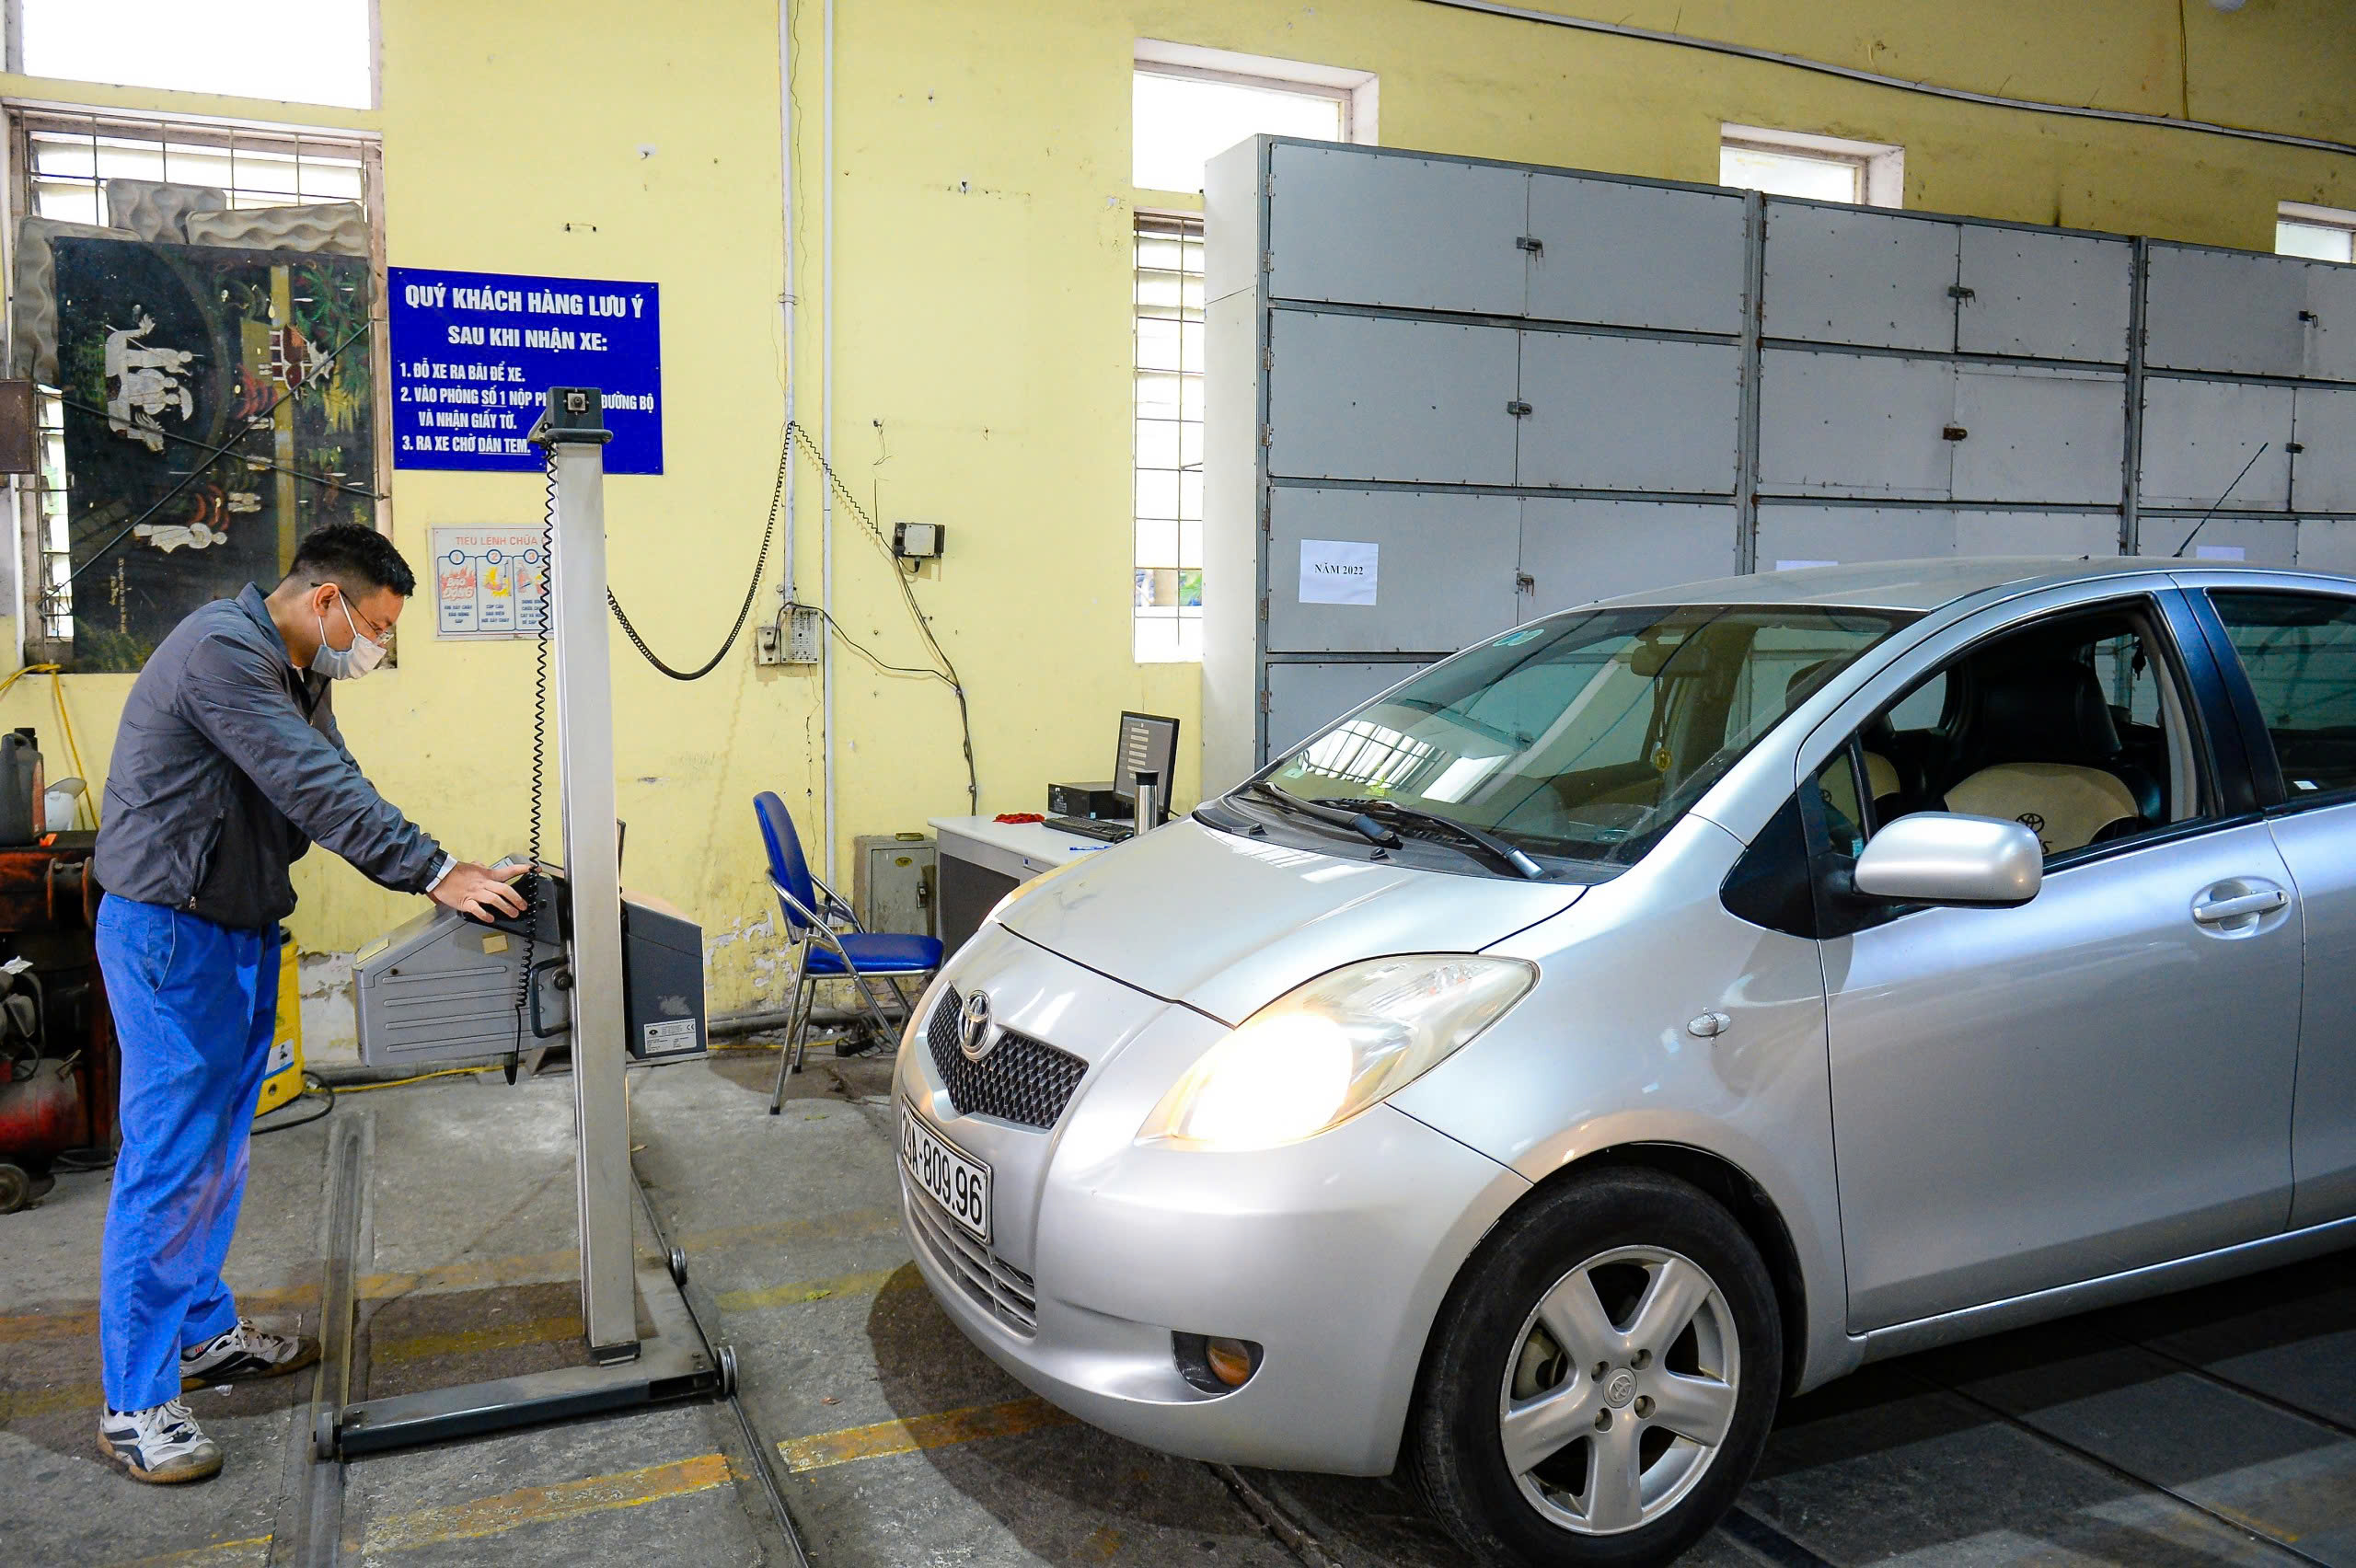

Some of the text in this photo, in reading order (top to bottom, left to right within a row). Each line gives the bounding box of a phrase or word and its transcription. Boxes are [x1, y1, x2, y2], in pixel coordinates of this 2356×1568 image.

[405, 282, 644, 318] QUÝ KHÁCH HÀNG LƯU Ý
[447, 325, 607, 353] SAU KHI NHẬN XE:
[399, 357, 526, 383] 1. ĐỖ XE RA BÃI ĐỂ XE.
[400, 386, 412, 402] 2.
[413, 384, 437, 403] VÀO
[439, 385, 479, 405] PHÒNG
[481, 385, 498, 405] SỐ
[500, 390, 506, 405] 1
[509, 387, 533, 409] NỘP
[601, 390, 638, 410] ĐƯỜNG
[639, 393, 654, 414] BỘ
[418, 408, 518, 431] VÀ NHẬN GIẤY TỜ.
[402, 432, 531, 455] 3. RA XE CHỜ DÁN TEM.
[491, 552, 498, 561] 2
[527, 552, 536, 561] 3
[1343, 565, 1363, 575] 2022
[902, 1111, 983, 1227] 29A-809.96
